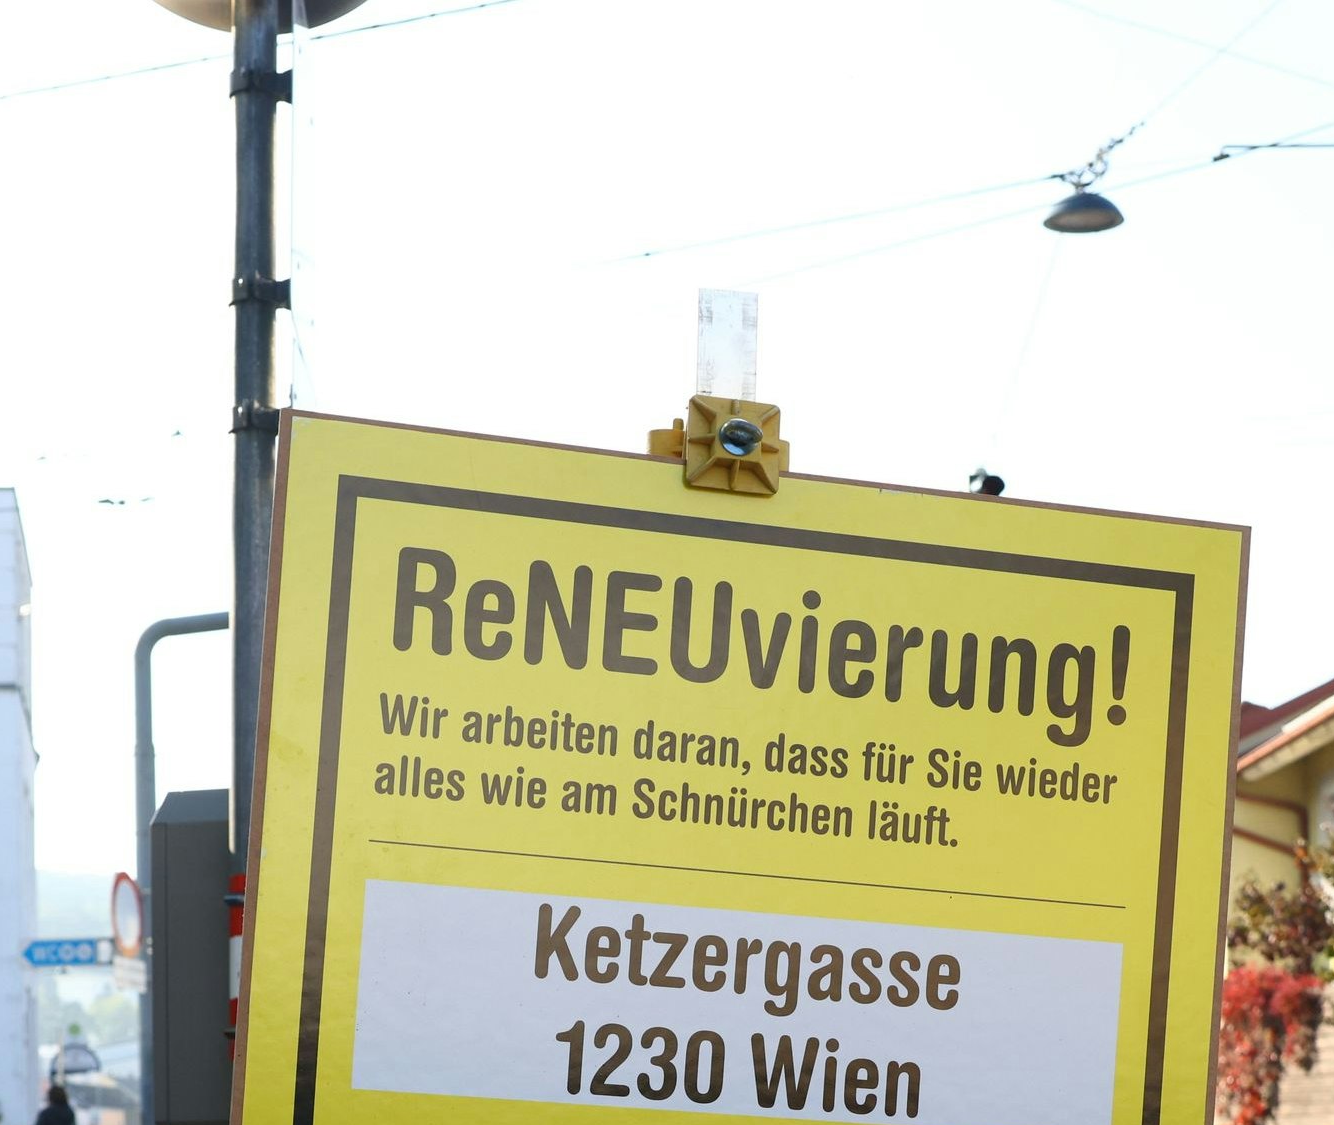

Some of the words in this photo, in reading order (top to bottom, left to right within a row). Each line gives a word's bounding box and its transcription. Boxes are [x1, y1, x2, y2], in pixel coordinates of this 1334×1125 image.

[393, 546, 1131, 748] ReNEUvierung!
[374, 755, 465, 802] alles
[481, 767, 547, 809] wie
[561, 781, 617, 816] am
[631, 777, 853, 838] Schnürchen
[868, 796, 958, 848] läuft.
[380, 693, 448, 739] Wir
[462, 706, 618, 756] arbeiten
[633, 720, 751, 776] daran,
[764, 732, 849, 779] dass
[862, 741, 914, 783] für
[926, 748, 982, 792] Sie
[996, 758, 1118, 805] wieder
[534, 903, 961, 1018] Ketzergasse
[555, 1020, 726, 1105] 1230
[750, 1033, 921, 1119] Wien
